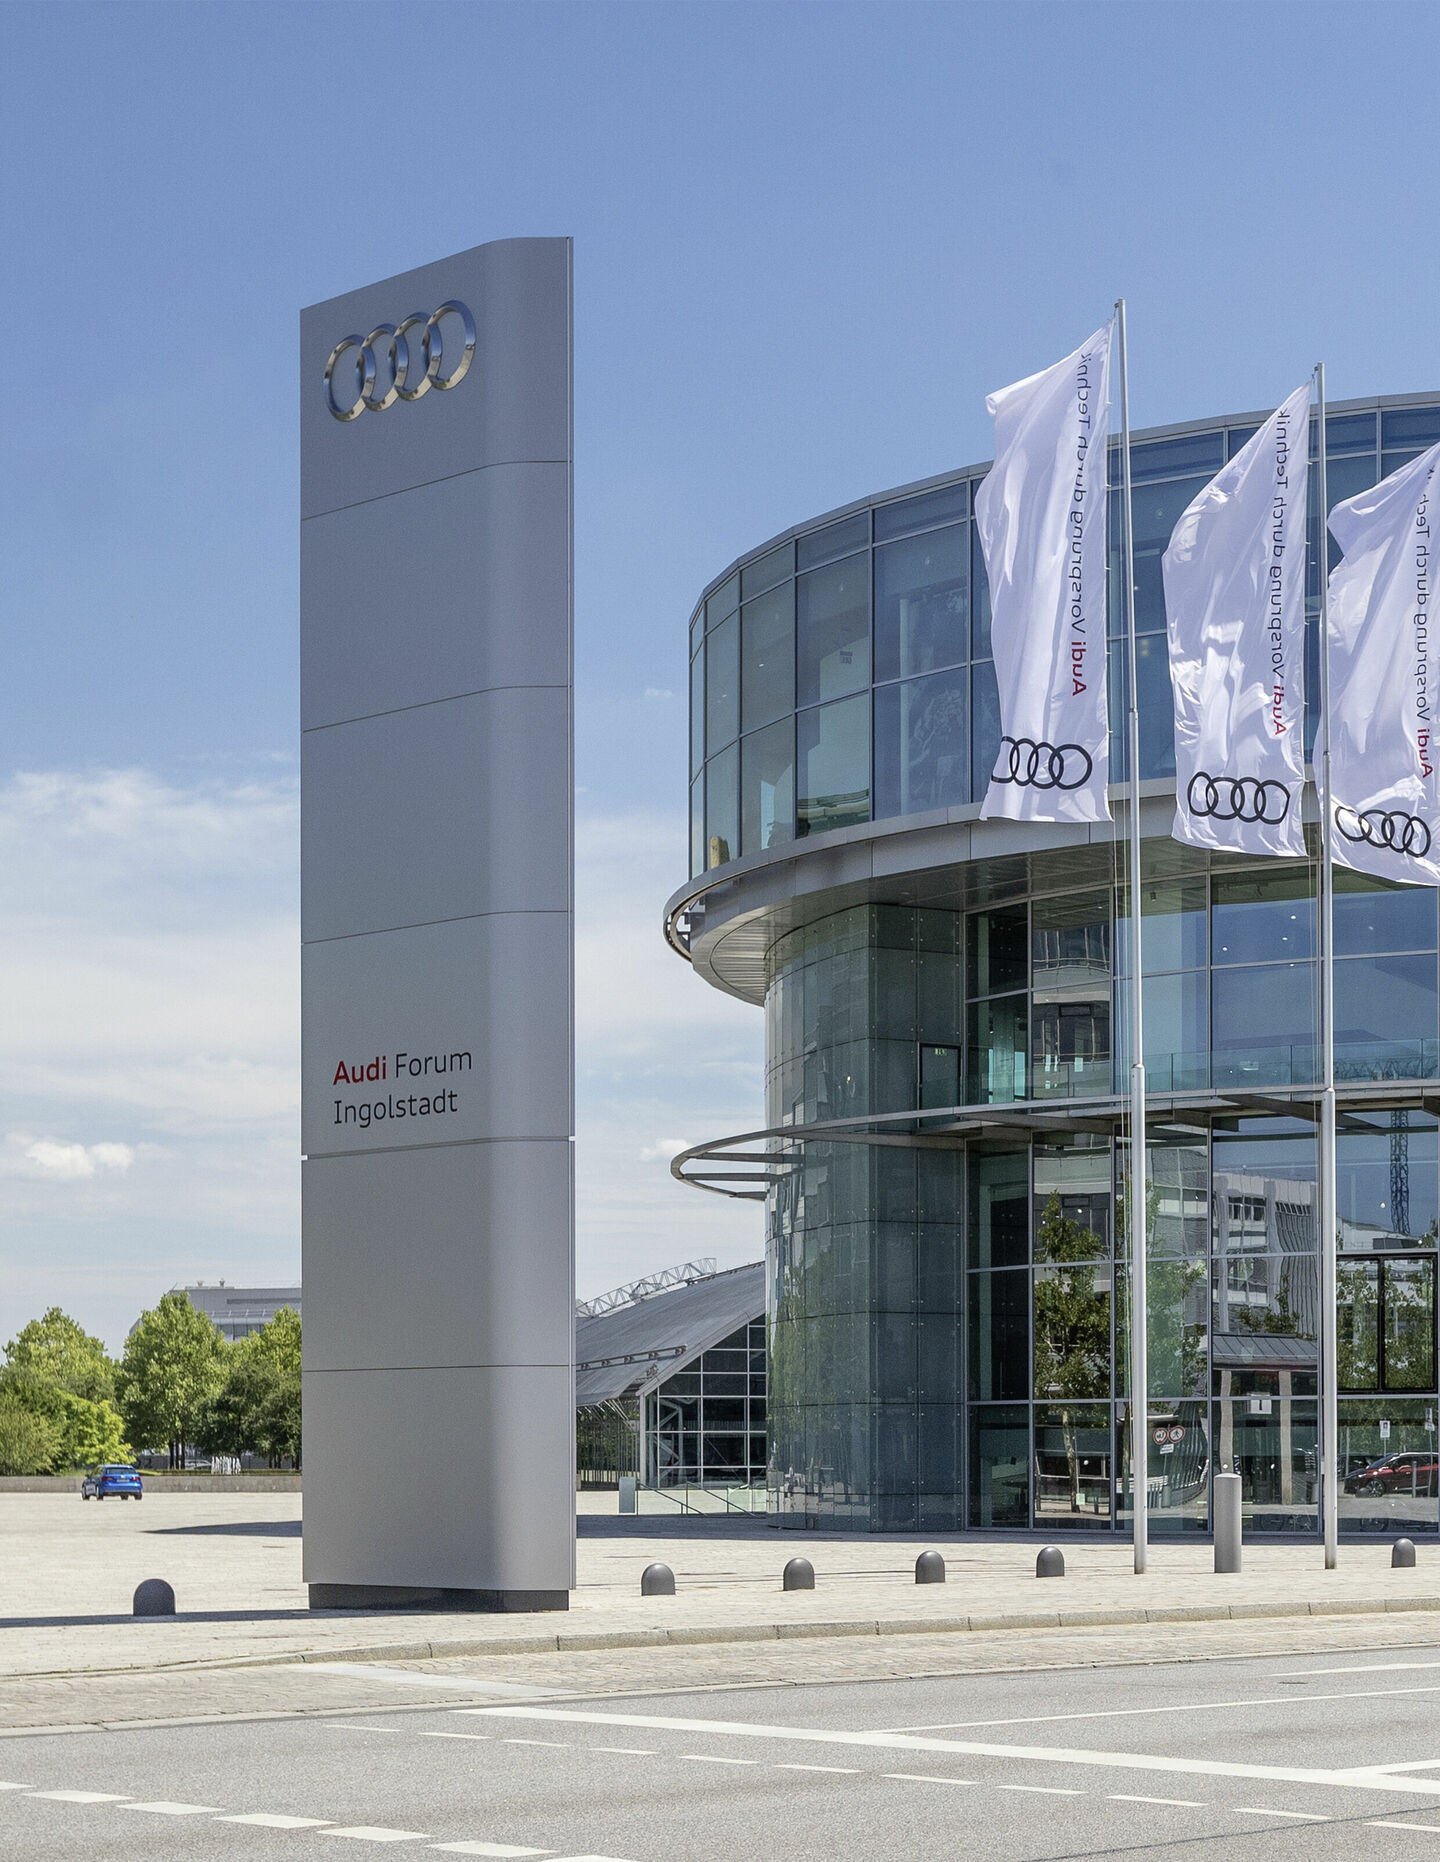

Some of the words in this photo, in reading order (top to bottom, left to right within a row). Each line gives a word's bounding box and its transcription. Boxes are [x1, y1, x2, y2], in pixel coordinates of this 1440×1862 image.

[333, 1056, 386, 1085] Audi
[395, 1052, 472, 1078] Forum
[334, 1089, 458, 1128] Ingolstadt
